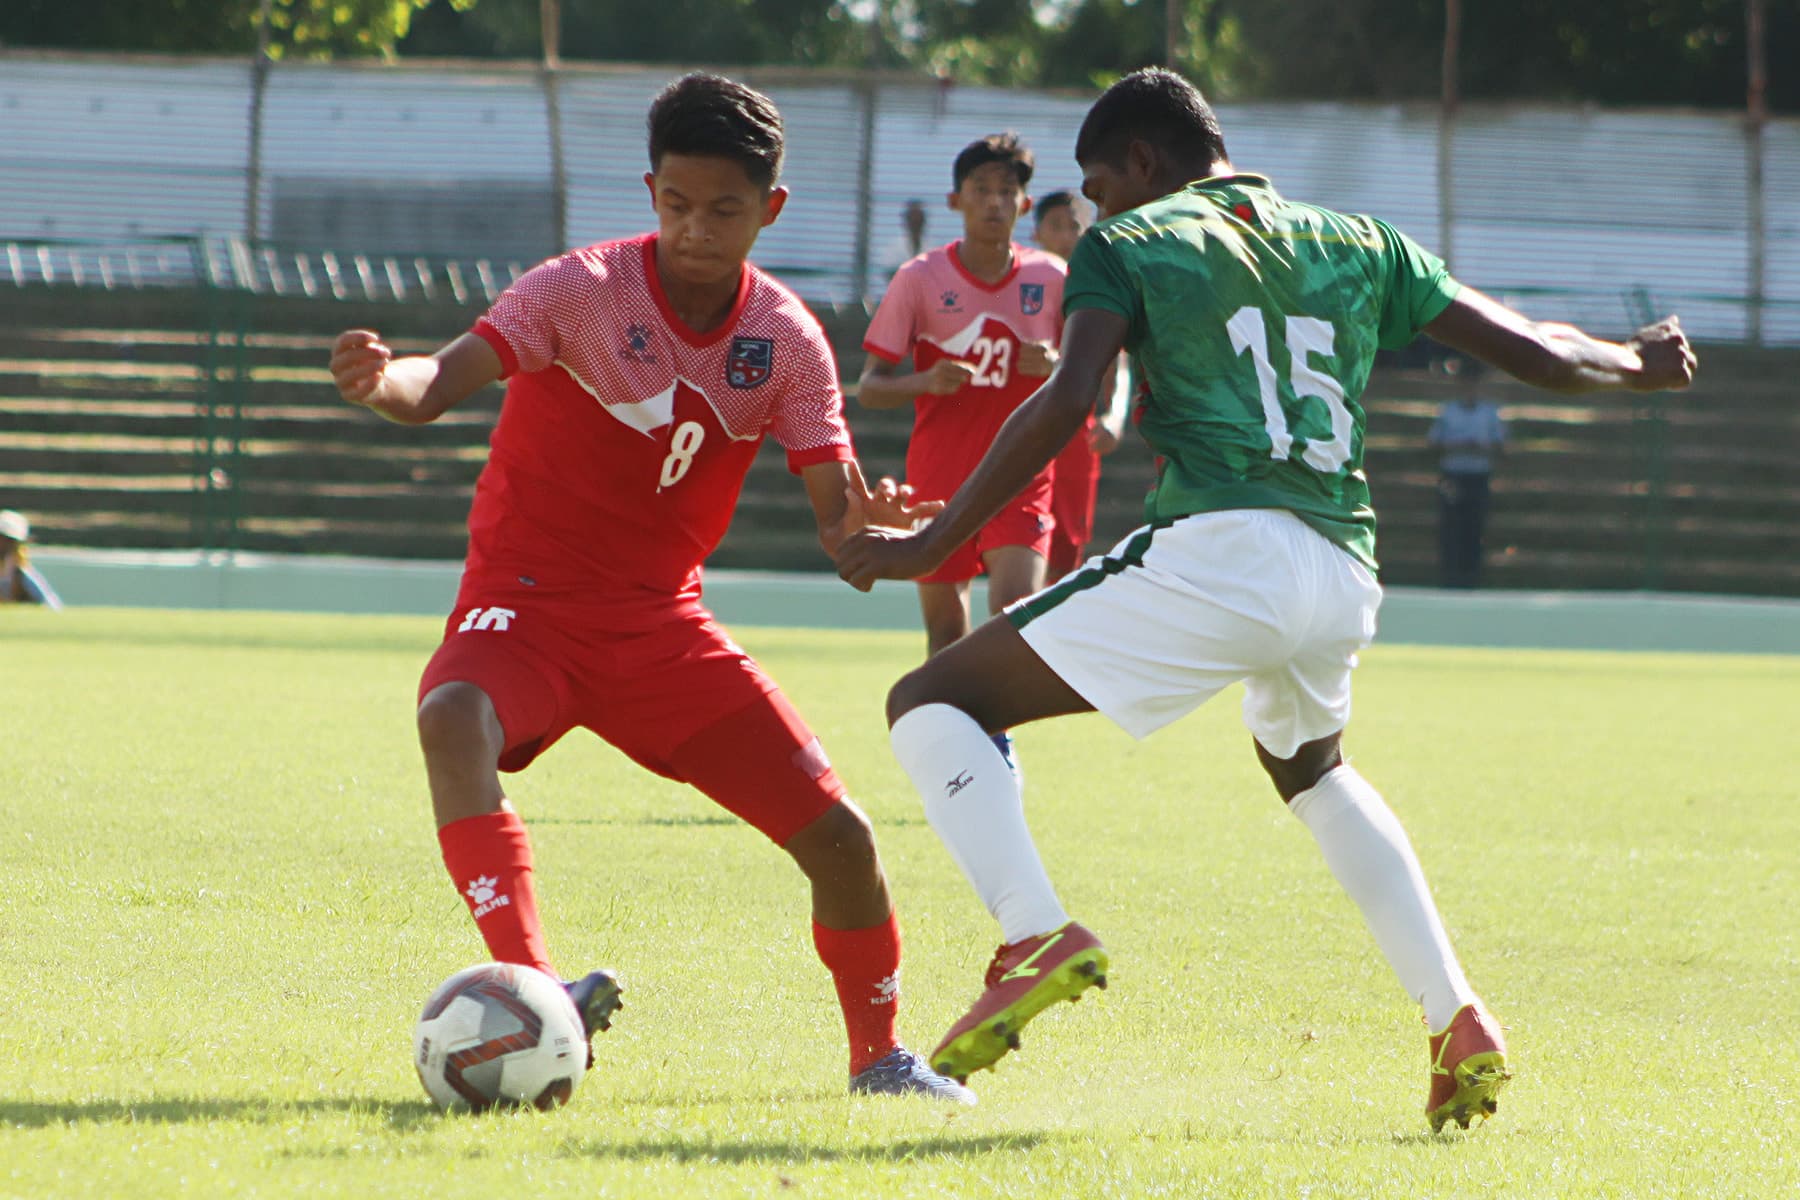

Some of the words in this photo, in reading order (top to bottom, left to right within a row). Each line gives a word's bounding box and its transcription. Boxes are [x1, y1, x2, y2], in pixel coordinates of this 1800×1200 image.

[971, 337, 1011, 388] 23
[1226, 306, 1354, 473] 15
[660, 421, 705, 487] 8
